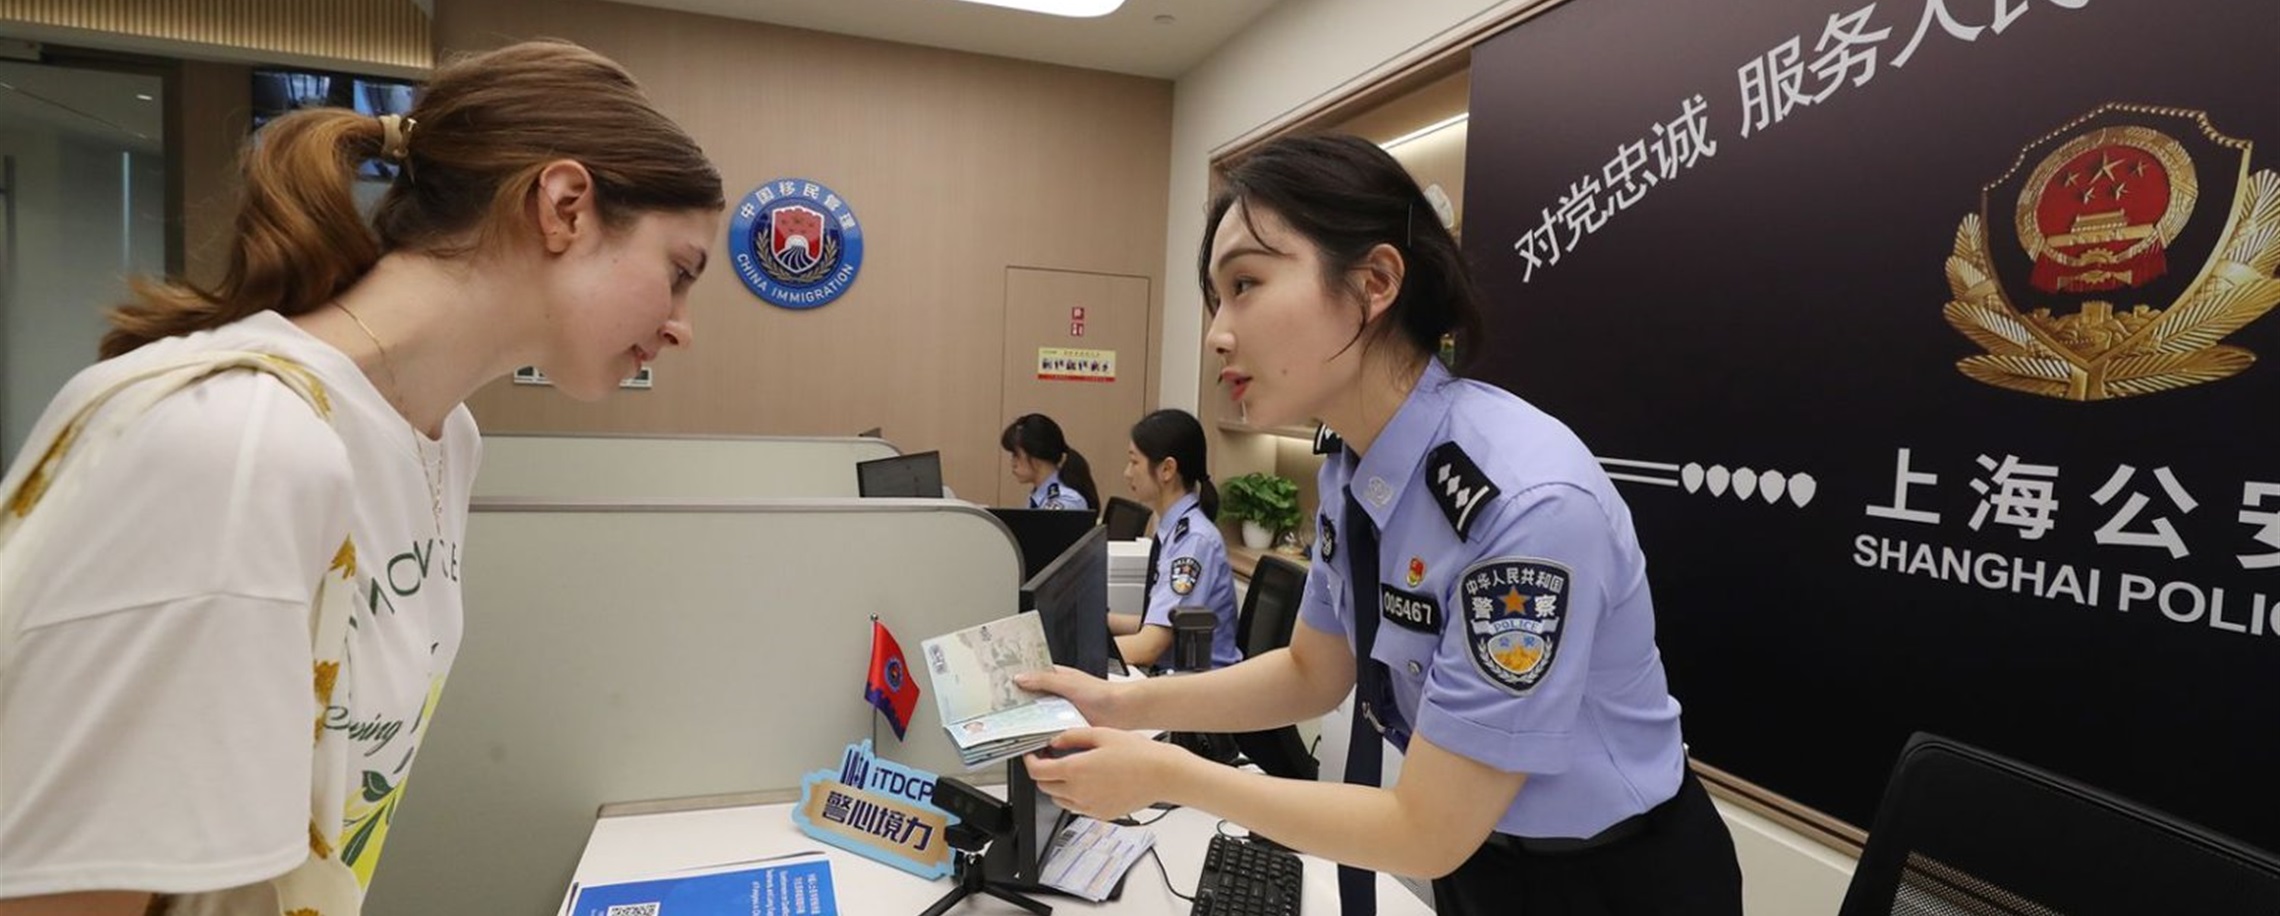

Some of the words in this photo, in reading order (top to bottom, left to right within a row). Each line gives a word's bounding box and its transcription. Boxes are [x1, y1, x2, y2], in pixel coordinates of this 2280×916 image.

[1514, 94, 1718, 283] 对党忠诚
[1737, 0, 2092, 137] 服务人
[740, 181, 856, 230] 中国移民管理
[737, 253, 767, 292] CHINA
[771, 263, 854, 304] IMMIGRATION
[1465, 567, 1564, 596] 中华人民共和国
[1852, 534, 2100, 607] SHANGHAI
[2118, 572, 2280, 637] POLI
[1493, 620, 1538, 633] POLICE
[822, 790, 933, 851] 警心境力
